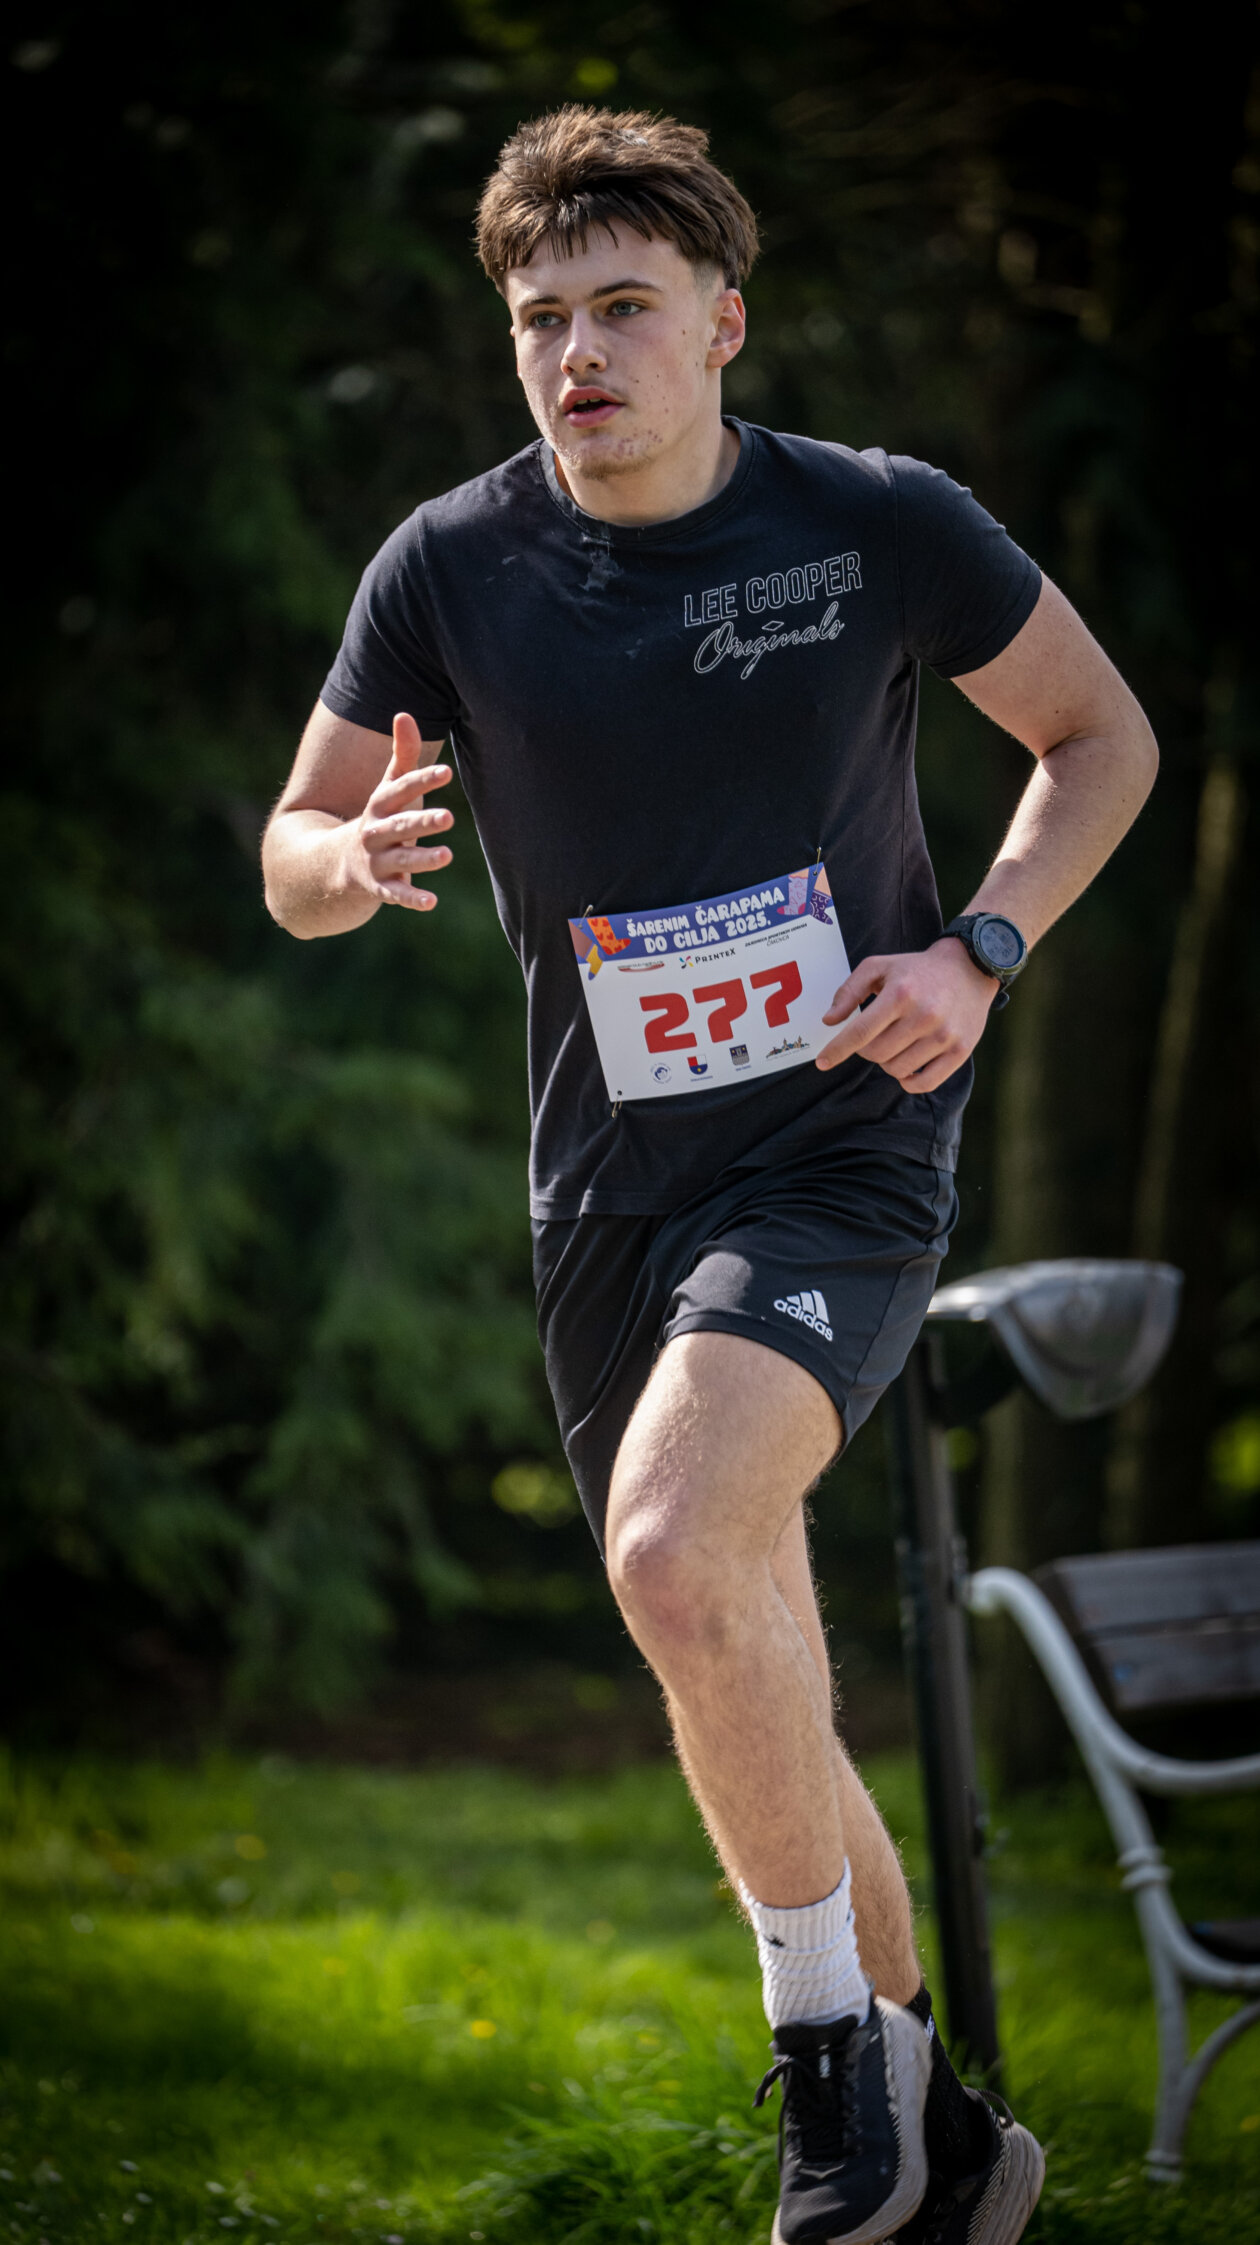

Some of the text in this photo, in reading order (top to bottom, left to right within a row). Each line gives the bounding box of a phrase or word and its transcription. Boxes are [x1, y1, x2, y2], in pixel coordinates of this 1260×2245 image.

[684, 551, 863, 628] LEE COOPER
[693, 601, 845, 680] Originals
[626, 886, 785, 938] ŠARENIM ČARAPAMA
[643, 935, 668, 954] DO
[673, 925, 720, 949] CILJA
[724, 911, 772, 938] 2025.
[639, 960, 803, 1054] 277
[773, 1299, 834, 1342] adidas
